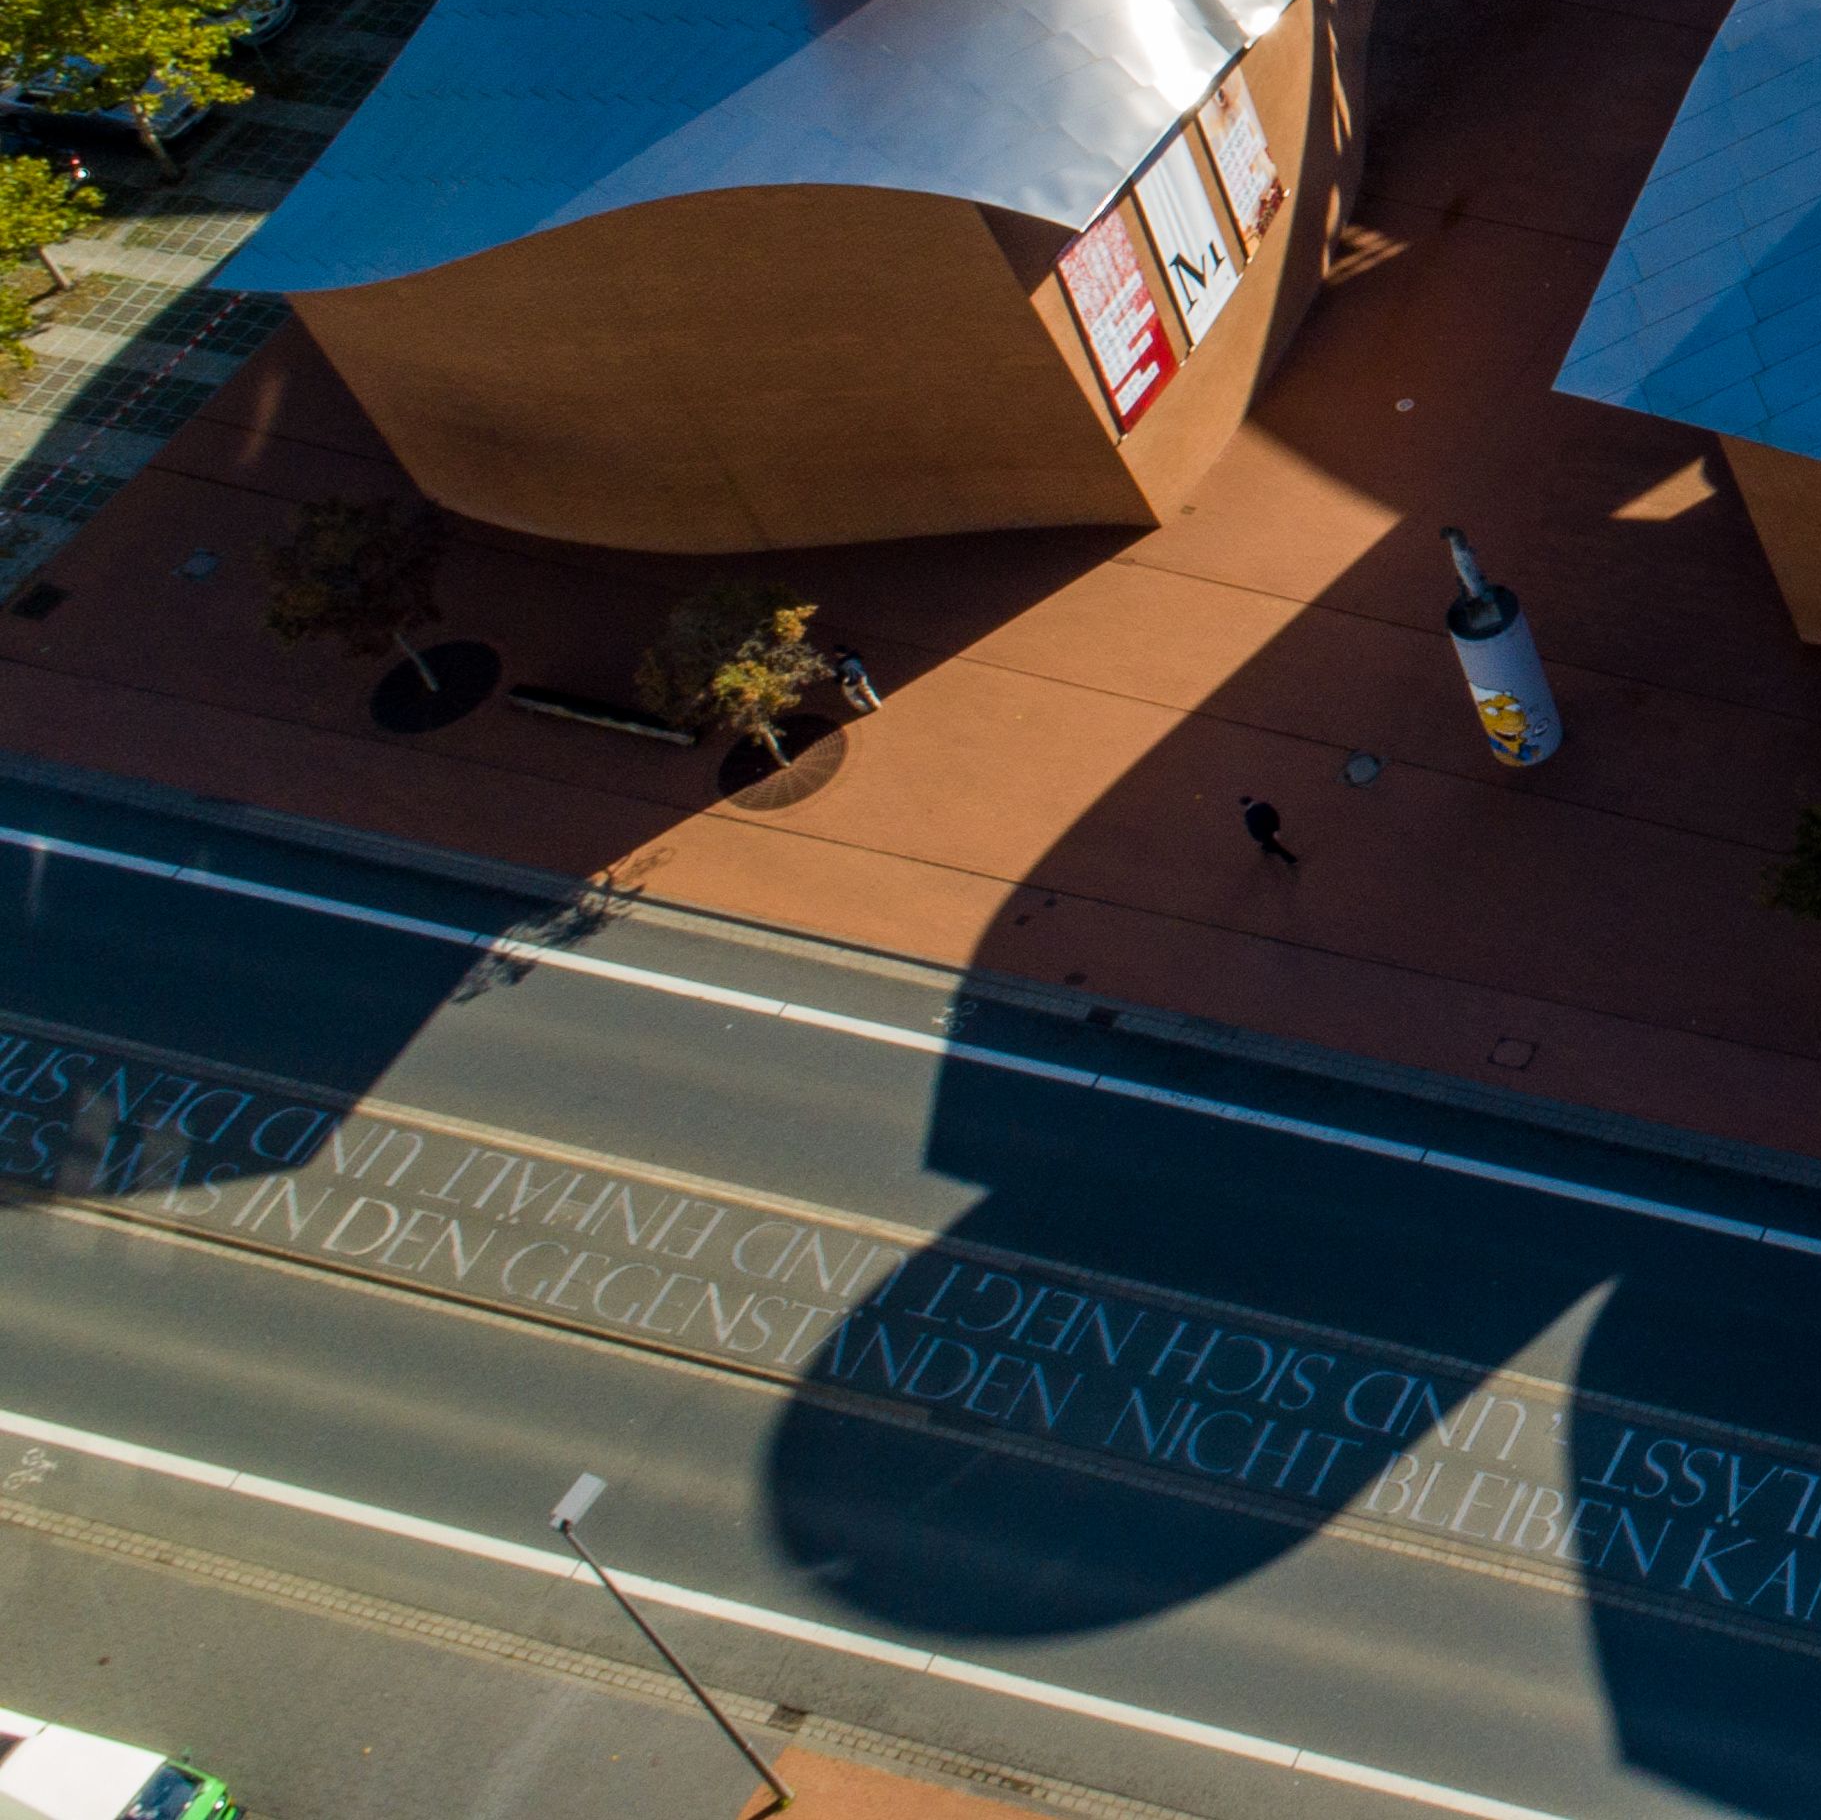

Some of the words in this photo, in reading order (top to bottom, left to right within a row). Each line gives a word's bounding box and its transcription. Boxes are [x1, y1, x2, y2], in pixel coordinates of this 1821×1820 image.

[79, 1064, 255, 1144] DEN
[251, 1107, 424, 1188] UND
[420, 1148, 728, 1259] EINHÄLT
[731, 1220, 908, 1308] UND
[90, 1135, 240, 1216] WAS
[232, 1175, 335, 1241] IN
[322, 1195, 500, 1282] DEN
[505, 1240, 1083, 1430] GEGENSTÄNDEN
[1104, 1386, 1363, 1497] NICHT
[1364, 1449, 1672, 1580] BLEIBEN
[905, 1264, 1151, 1365] NEIGT
[1149, 1319, 1334, 1412] SICH
[1343, 1370, 1526, 1460] UND
